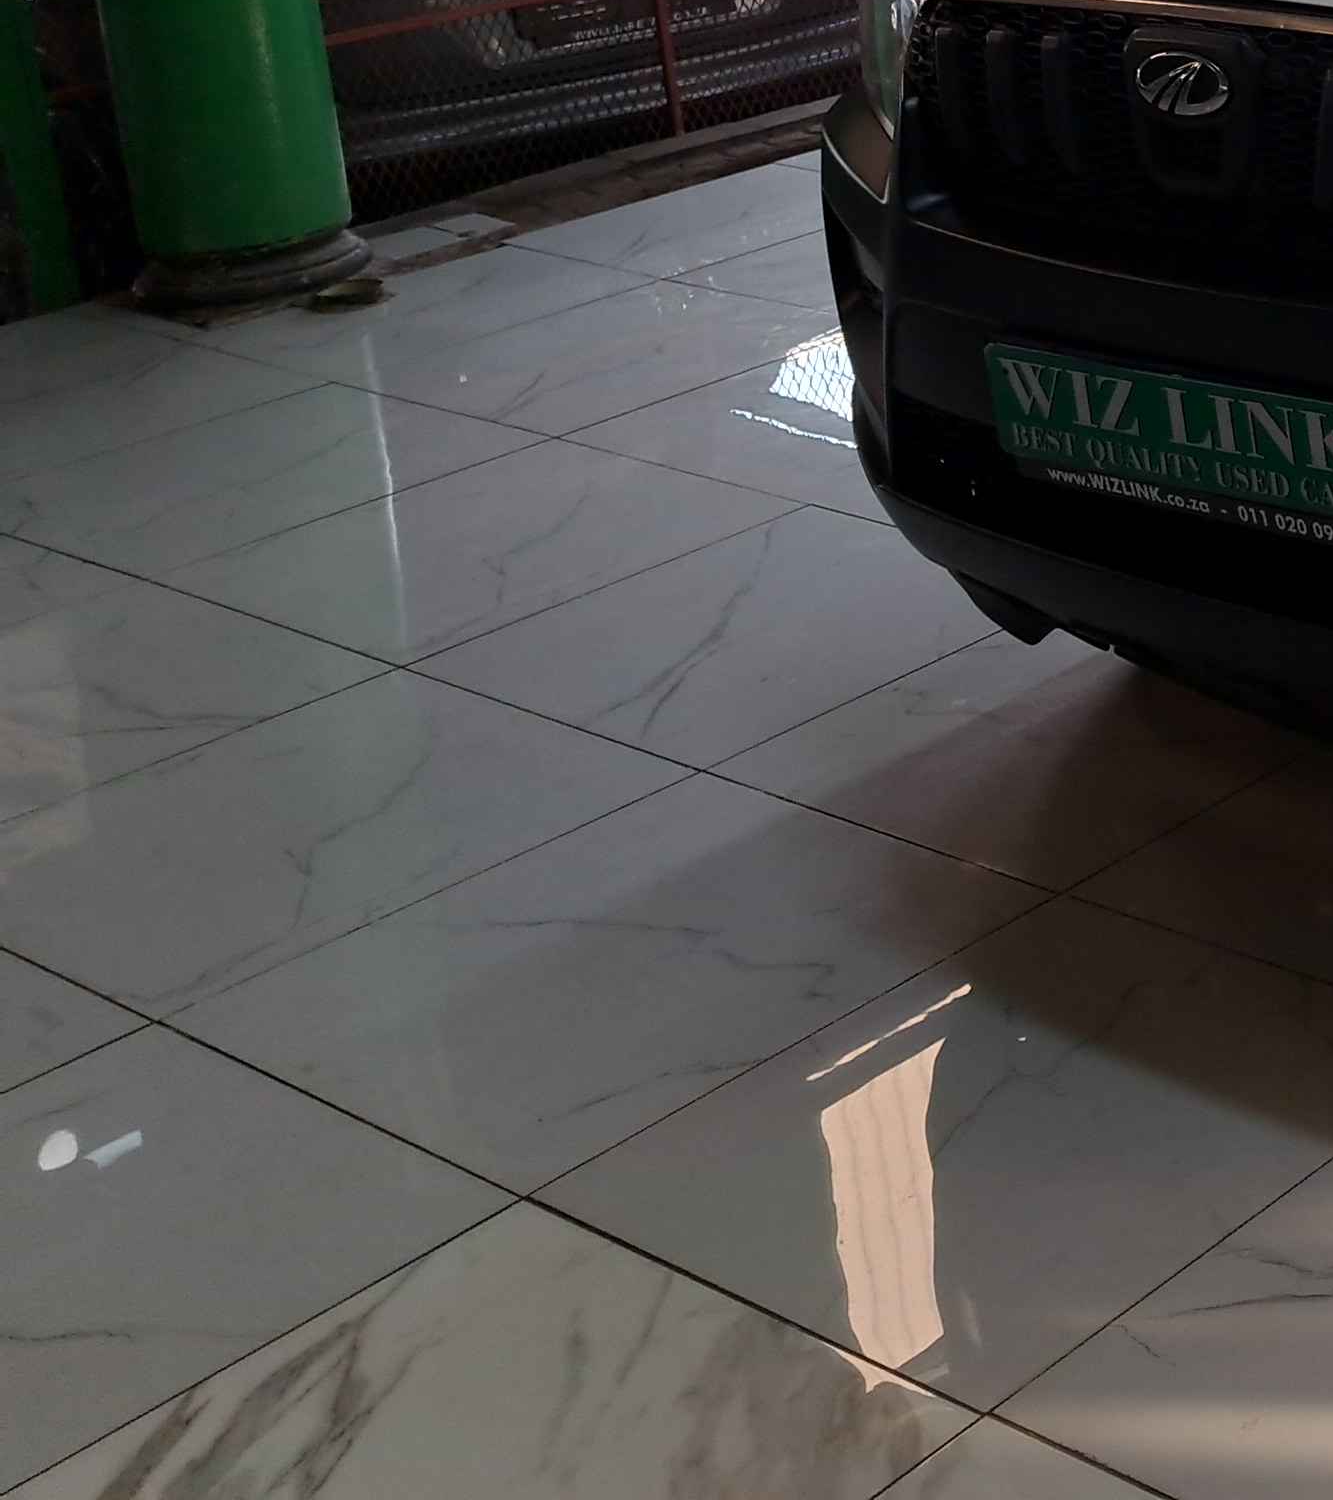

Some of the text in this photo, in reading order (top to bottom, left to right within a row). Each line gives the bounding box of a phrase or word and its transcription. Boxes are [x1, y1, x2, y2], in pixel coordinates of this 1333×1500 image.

[996, 357, 1141, 436] WIZ
[1012, 422, 1075, 456] BEST
[1086, 439, 1201, 482] QUALITY
[1216, 462, 1290, 499] USED
[1047, 468, 1210, 514] www.WIZLINK.co.za
[1237, 505, 1268, 527] 011
[1275, 513, 1307, 535] 020
